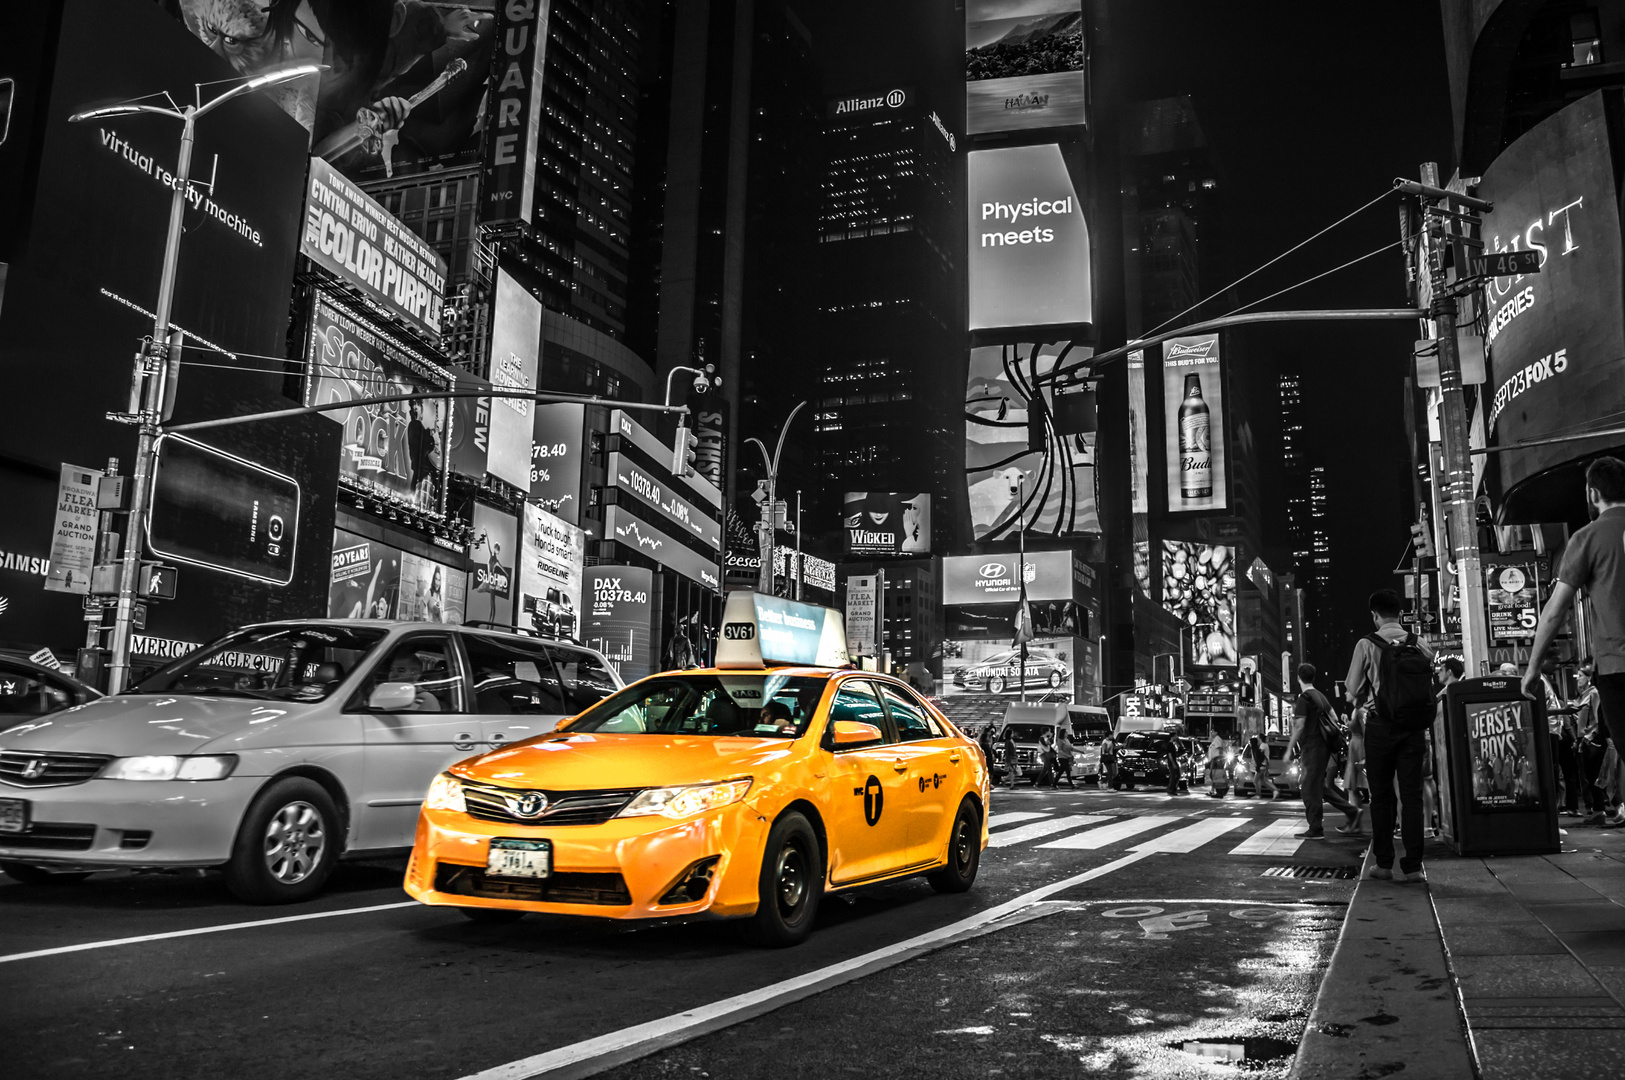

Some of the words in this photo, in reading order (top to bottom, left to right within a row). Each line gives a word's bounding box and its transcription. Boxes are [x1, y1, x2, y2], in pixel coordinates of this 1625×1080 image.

[836, 95, 884, 114] Allianz
[100, 128, 154, 174] virtual
[155, 166, 204, 210] reity
[205, 199, 263, 247] machine.
[491, 190, 513, 202] NYC
[329, 173, 345, 193] TONY
[344, 187, 364, 208] AWARD
[387, 219, 400, 236] BEST
[399, 228, 419, 253] MUSICAL
[982, 196, 1073, 223] Physical
[311, 178, 350, 222] CYNTHIA
[351, 208, 377, 242] ERIVO
[384, 234, 417, 273] HEATHER
[417, 257, 446, 295] HEADLEY
[981, 226, 1054, 247] meets
[306, 204, 323, 249] THE
[319, 212, 384, 291] COLOR
[382, 256, 444, 334] PURPLE
[1473, 257, 1488, 275] W
[1497, 255, 1518, 273] 46
[1525, 251, 1536, 265] St
[1498, 285, 1535, 331] SERIES
[339, 314, 355, 334] LLOYD
[355, 324, 376, 347] WEBBER
[1171, 345, 1210, 355] Budweiser
[510, 351, 522, 369] THE
[500, 357, 529, 387] LEARNING
[1494, 379, 1511, 414] SEPT
[1511, 370, 1525, 399] 23
[1525, 354, 1554, 389] FOX
[1554, 348, 1568, 373] 5
[621, 417, 632, 435] DAX
[354, 450, 364, 458] THE
[62, 485, 97, 497] BROADWA
[64, 493, 95, 508] FLEA
[630, 470, 660, 504] 10378.40
[670, 499, 689, 524] -0.08%
[58, 503, 98, 517] MARKET
[61, 521, 92, 532] GRAND
[250, 500, 259, 543] SAMSUNG
[57, 530, 95, 542] AUCTION
[537, 518, 554, 538] Truck
[554, 527, 573, 547] tough.
[534, 533, 555, 554] Honda
[555, 544, 574, 562] smart.
[537, 561, 569, 580] RIDGELINE
[594, 578, 621, 590] DAX
[975, 579, 1011, 587] HYUNDAI
[594, 590, 647, 603] 10378.40
[757, 606, 783, 625] Better
[782, 610, 816, 630] business
[725, 626, 754, 640] 3V61
[210, 651, 251, 668] EAGLE
[976, 667, 1008, 677] HYUNDAI
[1010, 666, 1039, 677] SOATA
[1472, 705, 1522, 738] JERSEY
[1480, 732, 1517, 759] BOYS
[854, 787, 864, 796] NYC
